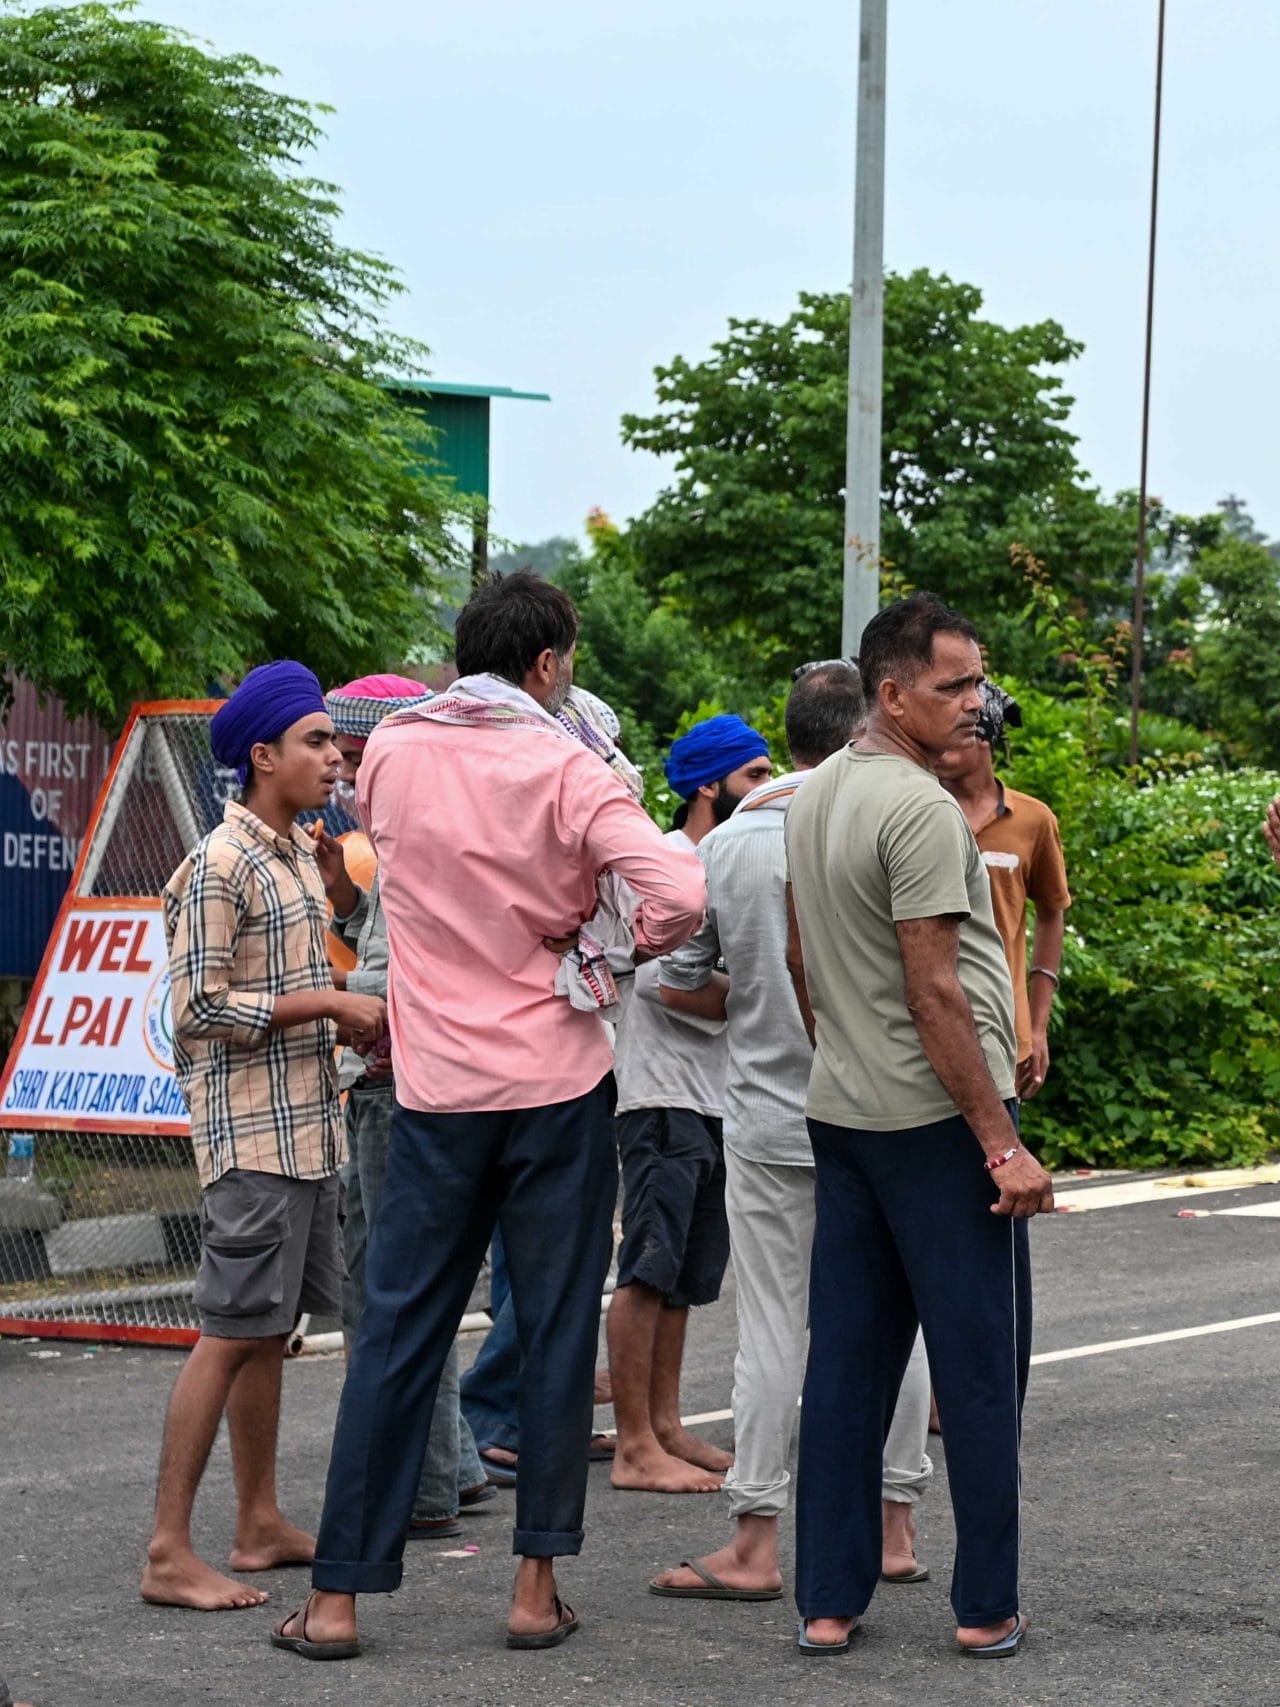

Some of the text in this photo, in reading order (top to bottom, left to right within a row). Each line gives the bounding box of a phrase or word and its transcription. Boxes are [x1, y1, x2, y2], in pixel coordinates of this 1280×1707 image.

[25, 741, 91, 780] FIRST
[30, 787, 64, 821] OF
[4, 832, 83, 871] DEFEN
[58, 919, 153, 973] WEL
[6, 1069, 188, 1116] SHRI KARTARPUR SAHI
